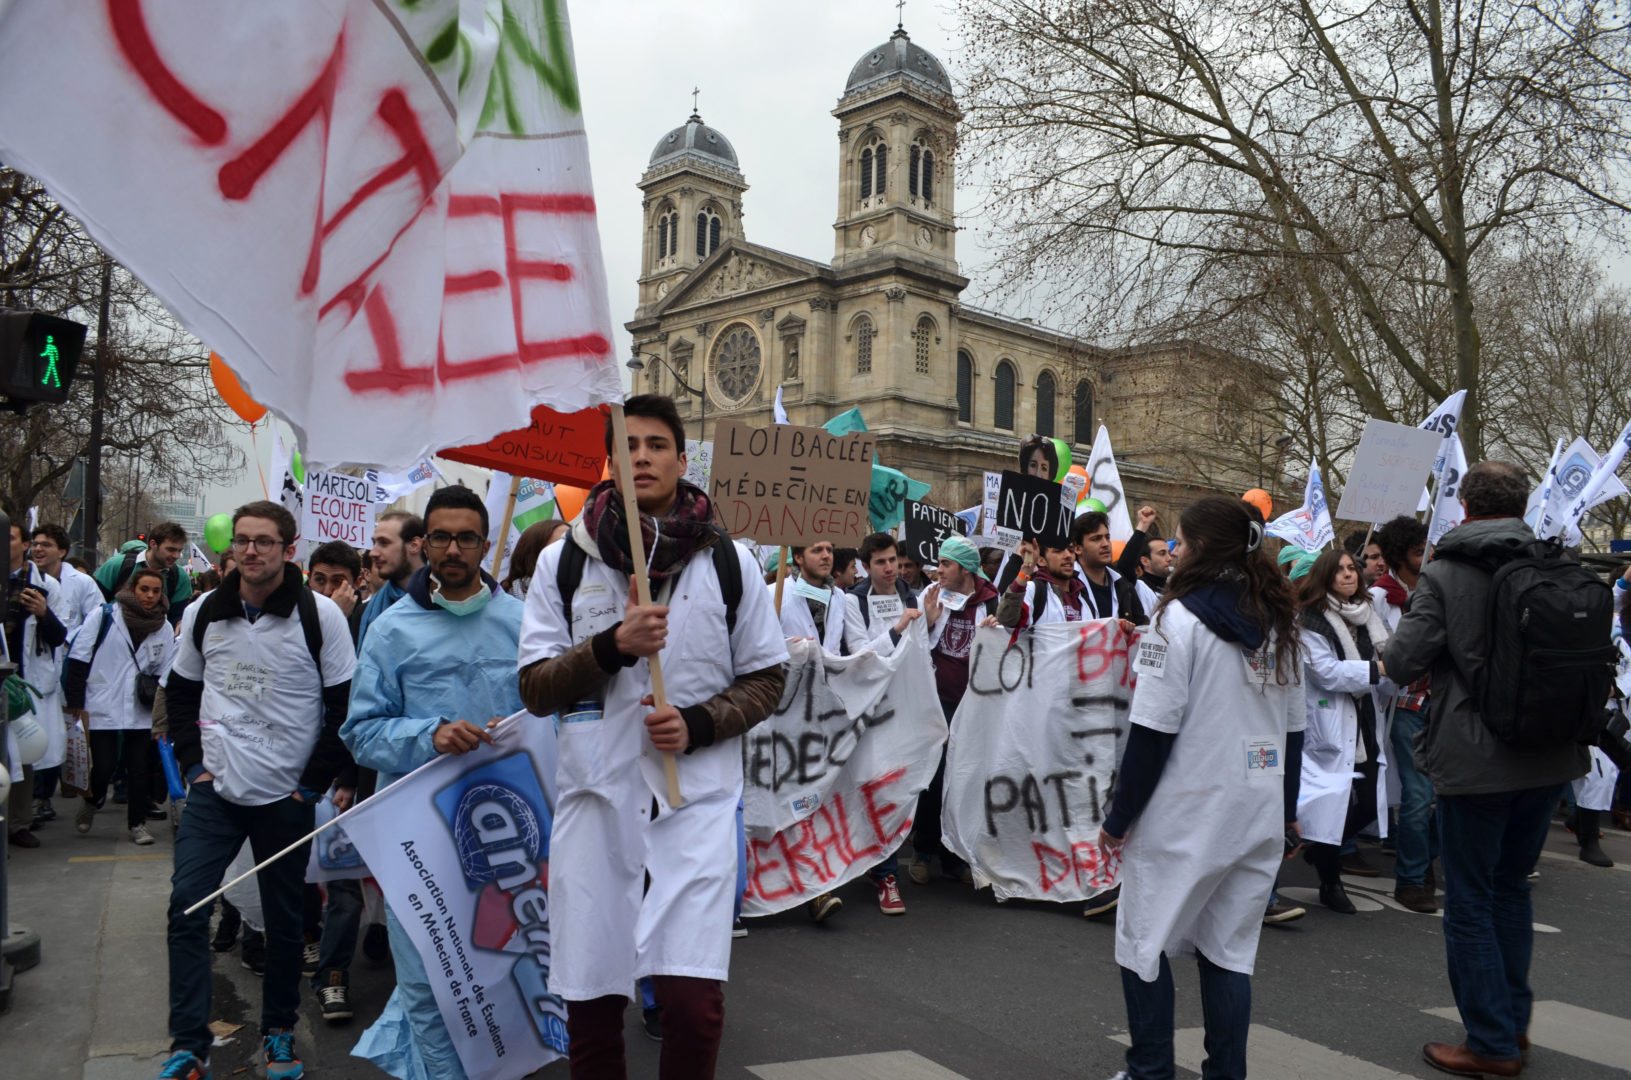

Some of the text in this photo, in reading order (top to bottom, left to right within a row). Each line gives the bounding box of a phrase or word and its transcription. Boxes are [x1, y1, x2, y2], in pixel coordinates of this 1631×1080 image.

[730, 427, 873, 463] LOI BACLÉE
[306, 472, 374, 504] MARISOL
[713, 472, 838, 505] MÉDECINE
[845, 489, 867, 507] EN
[311, 495, 367, 523] ECOUTE
[728, 500, 860, 537] DANGER
[912, 501, 960, 531] PATIENT
[1003, 487, 1073, 539] NON
[970, 627, 1034, 696] LOI
[400, 839, 506, 1058] Association Nationale des Étudiants
[407, 892, 478, 1039] en Médecine de France
